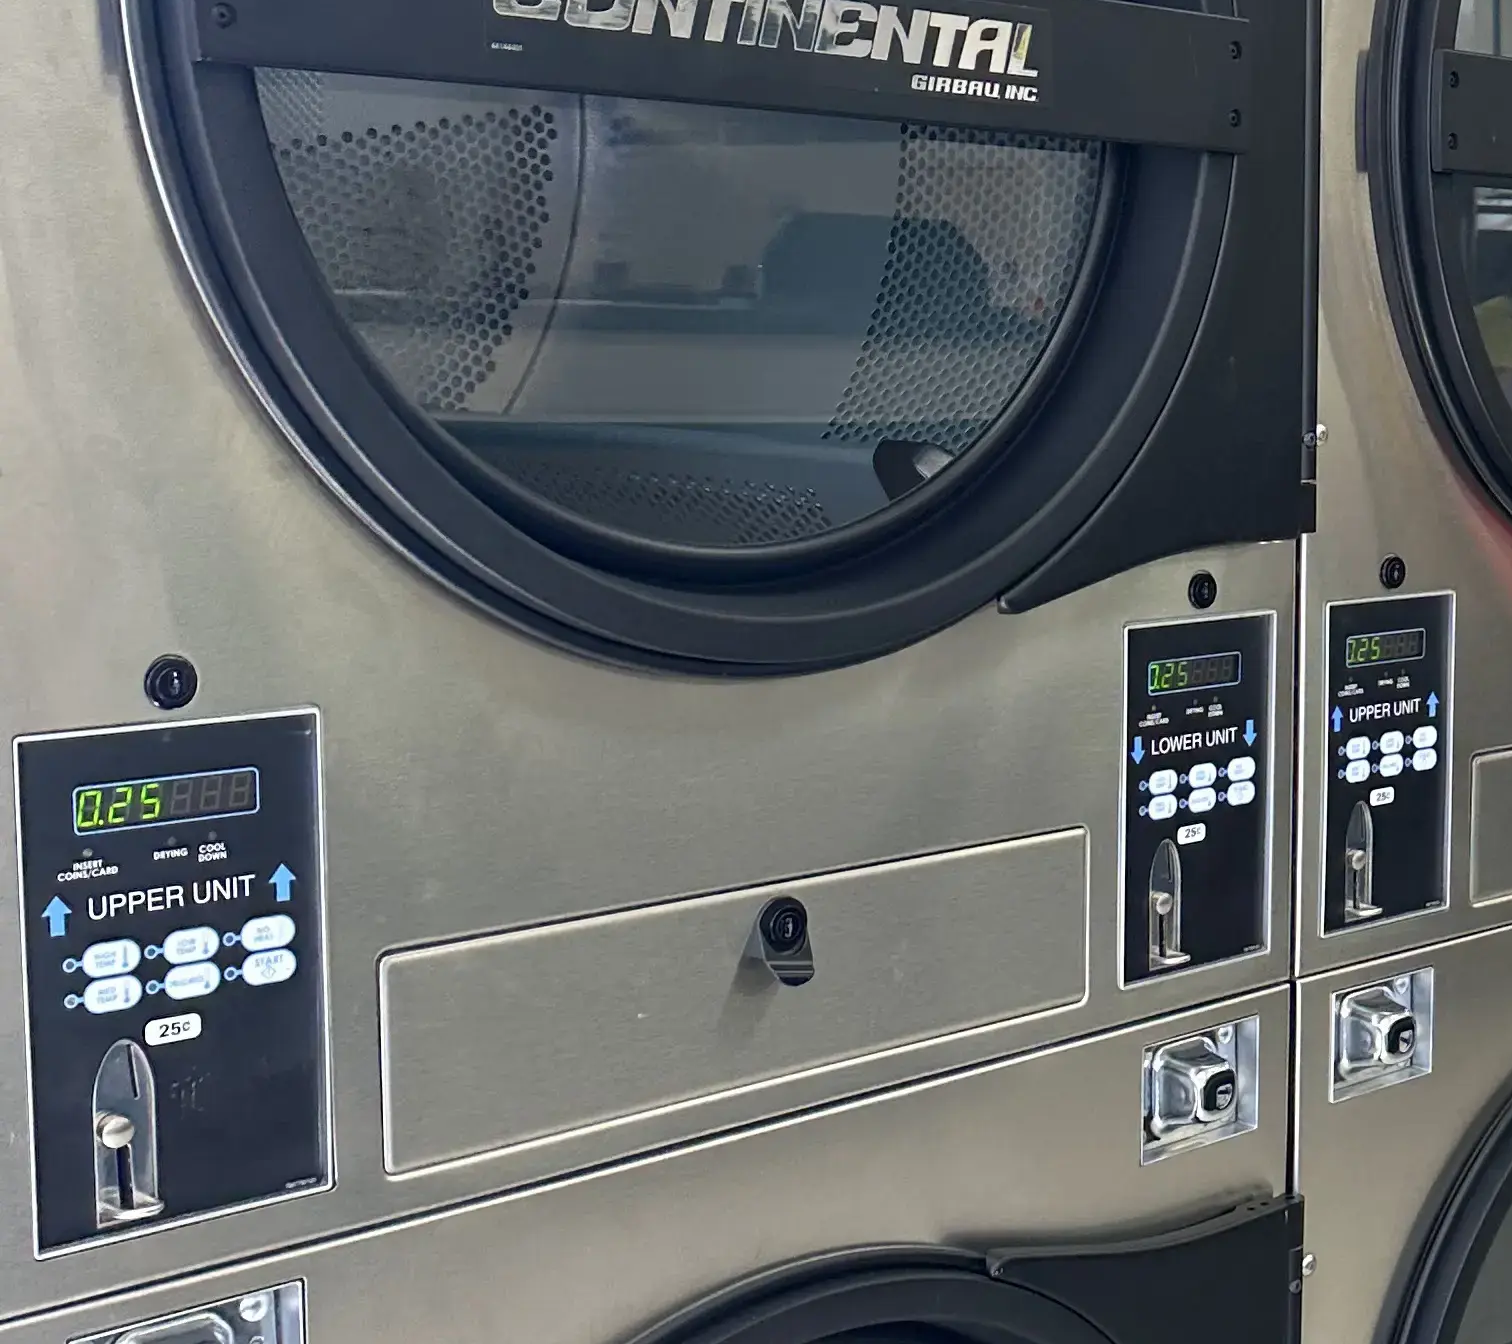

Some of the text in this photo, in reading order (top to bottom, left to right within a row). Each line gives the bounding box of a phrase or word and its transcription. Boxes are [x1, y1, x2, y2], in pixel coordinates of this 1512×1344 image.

[1349, 697, 1422, 723] UPPER UNIT
[1151, 726, 1238, 755] LOWER UNIT
[77, 783, 161, 828] 0.25
[153, 847, 188, 861] DRYING
[198, 842, 226, 854] COOL
[198, 851, 227, 863] DOWN
[72, 858, 103, 871] INSERT
[88, 874, 256, 921] UPPER UNIT
[254, 954, 284, 968] START
